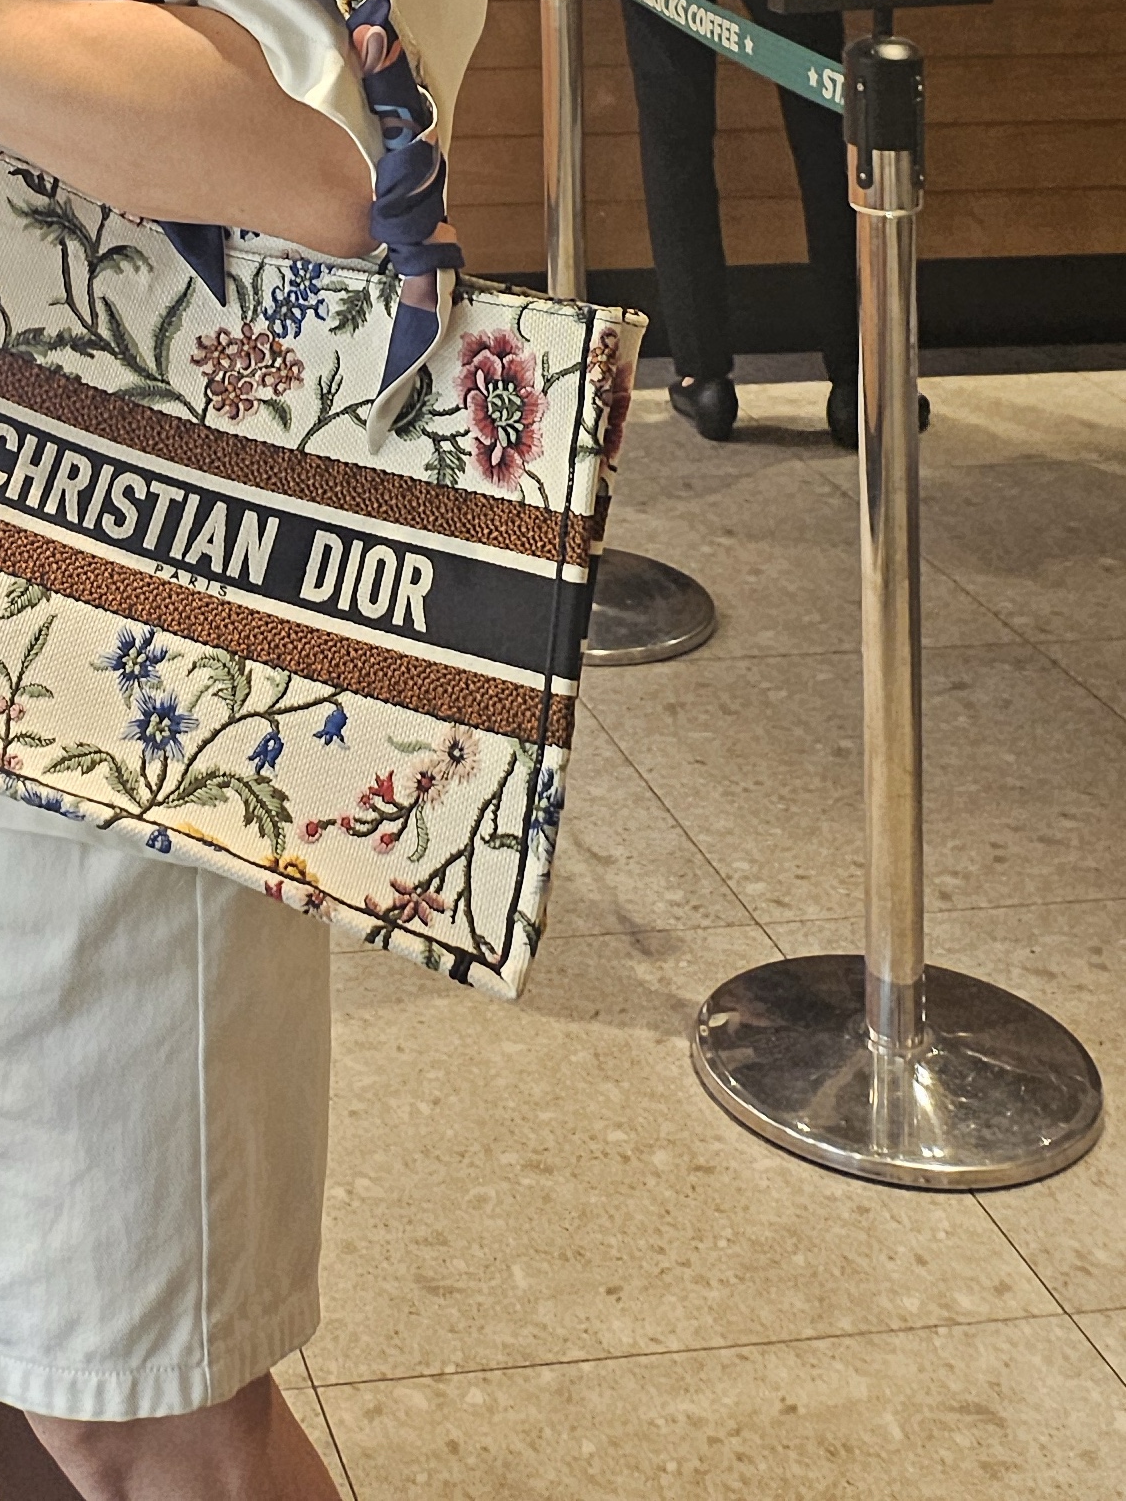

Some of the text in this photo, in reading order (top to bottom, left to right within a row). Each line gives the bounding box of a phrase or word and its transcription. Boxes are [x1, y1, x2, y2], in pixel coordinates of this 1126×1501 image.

[688, 4, 740, 53] COFFEE
[154, 563, 228, 597] PARIS
[300, 530, 435, 634] DIOR
